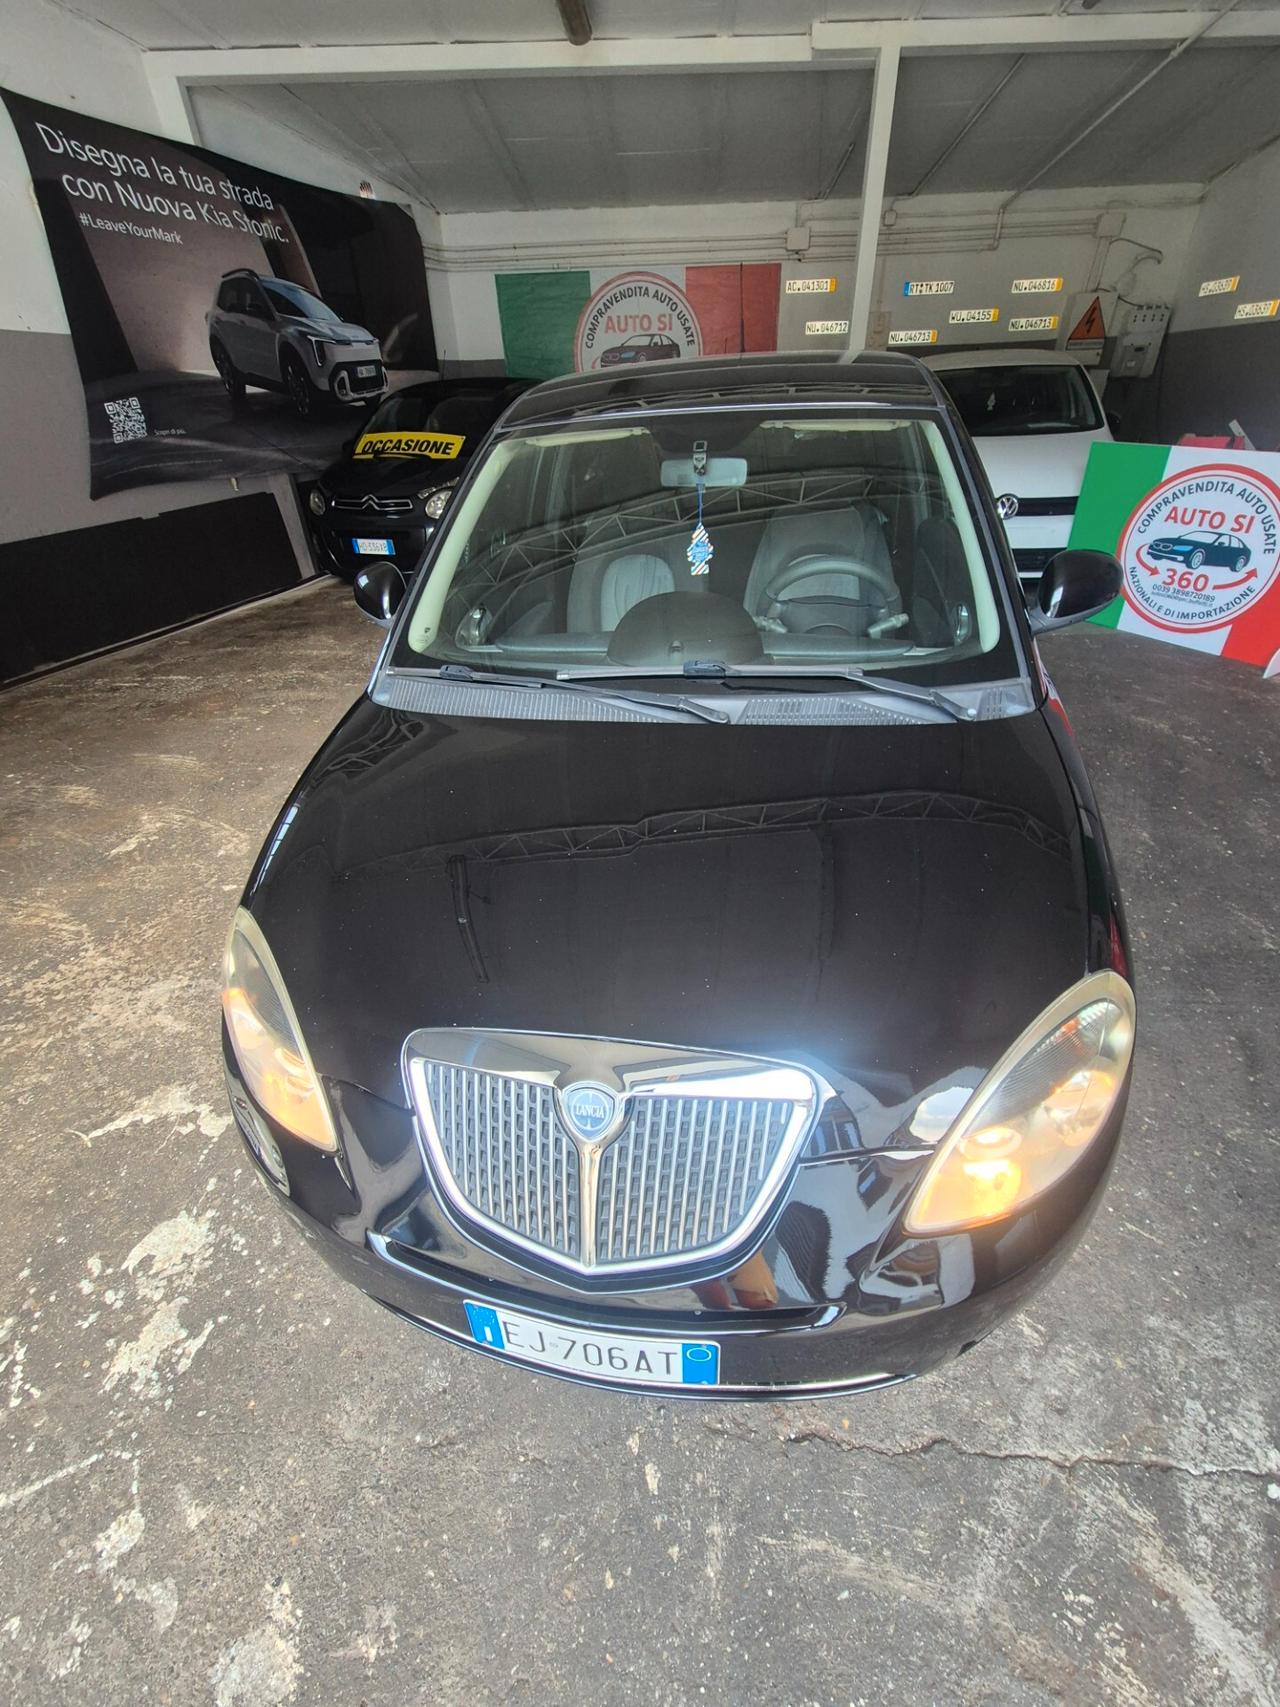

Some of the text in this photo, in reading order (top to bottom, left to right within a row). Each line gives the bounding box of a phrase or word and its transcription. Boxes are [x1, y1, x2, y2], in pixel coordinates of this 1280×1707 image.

[35, 121, 274, 211] Disegna la tua strada
[62, 174, 289, 243] con Nuova Kia Stonic.
[79, 212, 184, 245] #LeaveYourMark
[585, 286, 695, 349] COMPRAVENDITA AUTO USATE
[604, 313, 673, 334] AUTO SI
[361, 439, 455, 455] OCCASIONE
[1137, 481, 1277, 555] COMPRAVENDITA AUTO USATE
[1164, 506, 1255, 534] AUTO SI
[1129, 566, 1157, 609] NAZIONALI
[1164, 606, 1175, 617] DI
[1176, 585, 1256, 620] IMPORTAZIONE
[1152, 583, 1171, 594] 0039
[1162, 568, 1209, 592] 360
